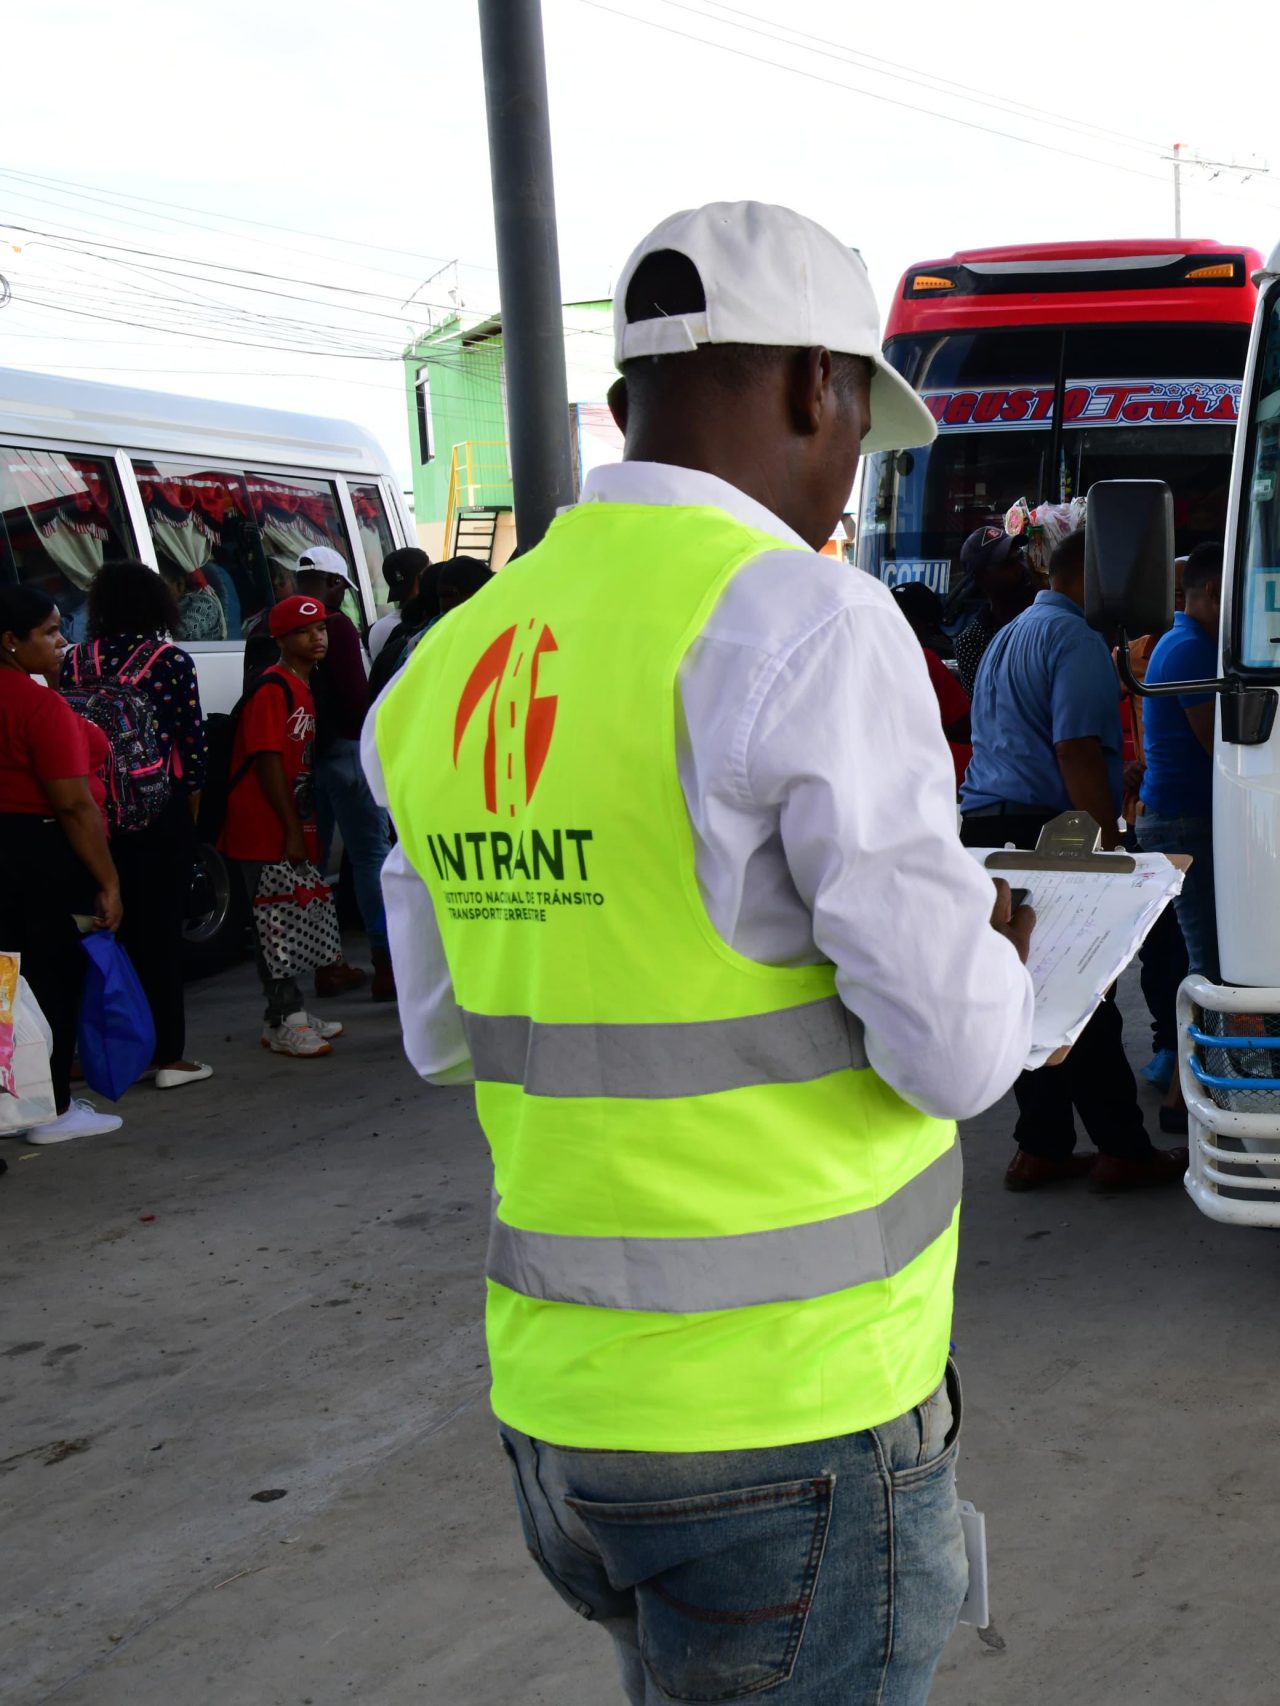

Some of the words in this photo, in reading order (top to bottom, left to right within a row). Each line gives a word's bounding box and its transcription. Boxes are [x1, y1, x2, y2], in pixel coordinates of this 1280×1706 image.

[923, 386, 1087, 424] UGUSTO
[1094, 384, 1240, 423] Tours
[883, 562, 946, 594] COTUI
[426, 829, 594, 881] INTRANT
[536, 889, 605, 906] TRÁNSITO
